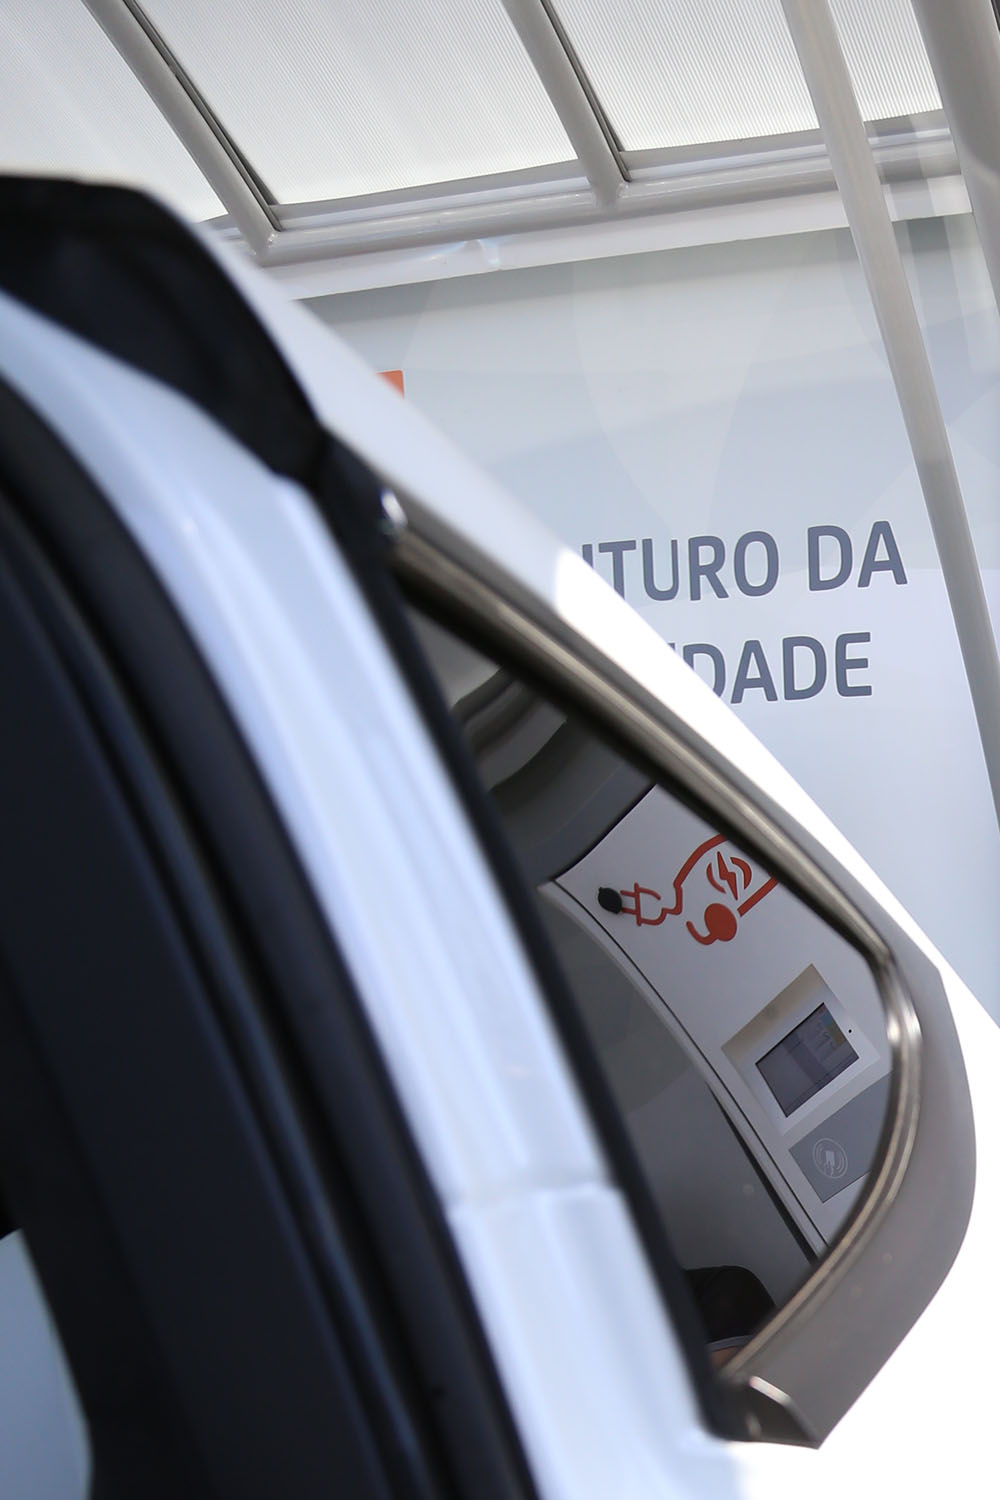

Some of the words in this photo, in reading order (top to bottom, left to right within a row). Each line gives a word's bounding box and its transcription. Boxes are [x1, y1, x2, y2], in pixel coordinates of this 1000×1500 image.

[582, 530, 778, 602] TURO
[807, 520, 908, 592] DA
[668, 632, 873, 704] DADE
